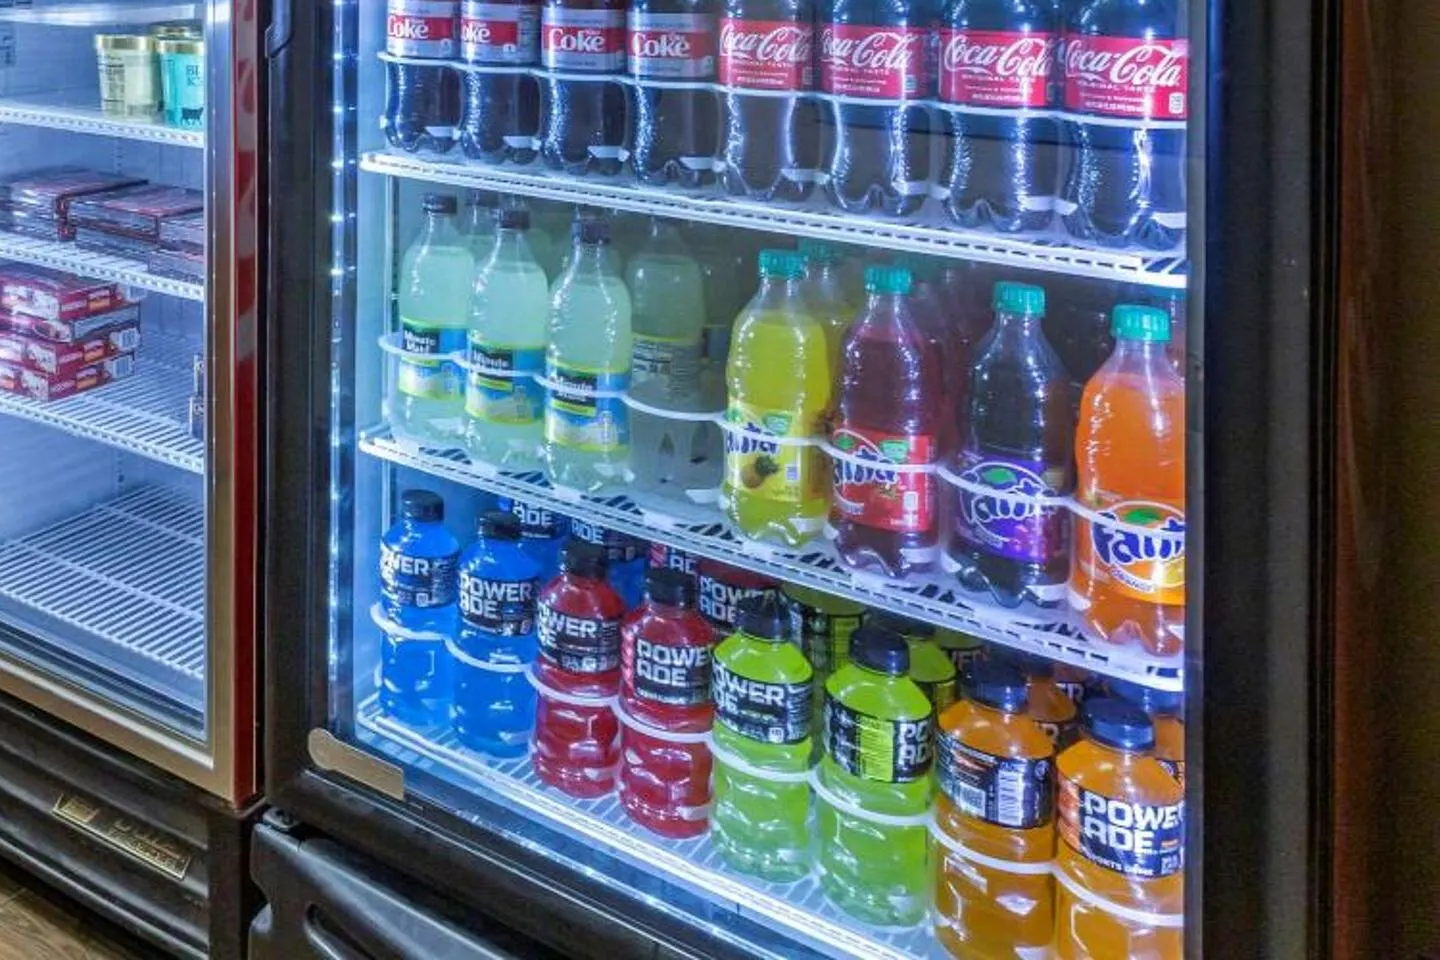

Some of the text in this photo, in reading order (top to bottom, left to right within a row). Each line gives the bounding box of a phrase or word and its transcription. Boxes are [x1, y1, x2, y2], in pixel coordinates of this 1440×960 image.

[387, 13, 430, 40] Coke
[462, 21, 491, 43] oke
[547, 27, 605, 52] Coke
[719, 23, 810, 63] Coca-Cola
[631, 31, 691, 58] Coke
[820, 28, 917, 69] Coca-Cola
[944, 33, 1054, 78] Coca-Cola
[1065, 39, 1186, 87] Coca-Cola
[1091, 510, 1185, 565] Fant
[459, 569, 532, 602] POWER
[637, 639, 710, 668] POWE
[637, 658, 688, 687] ADE
[1084, 816, 1155, 854] ADE
